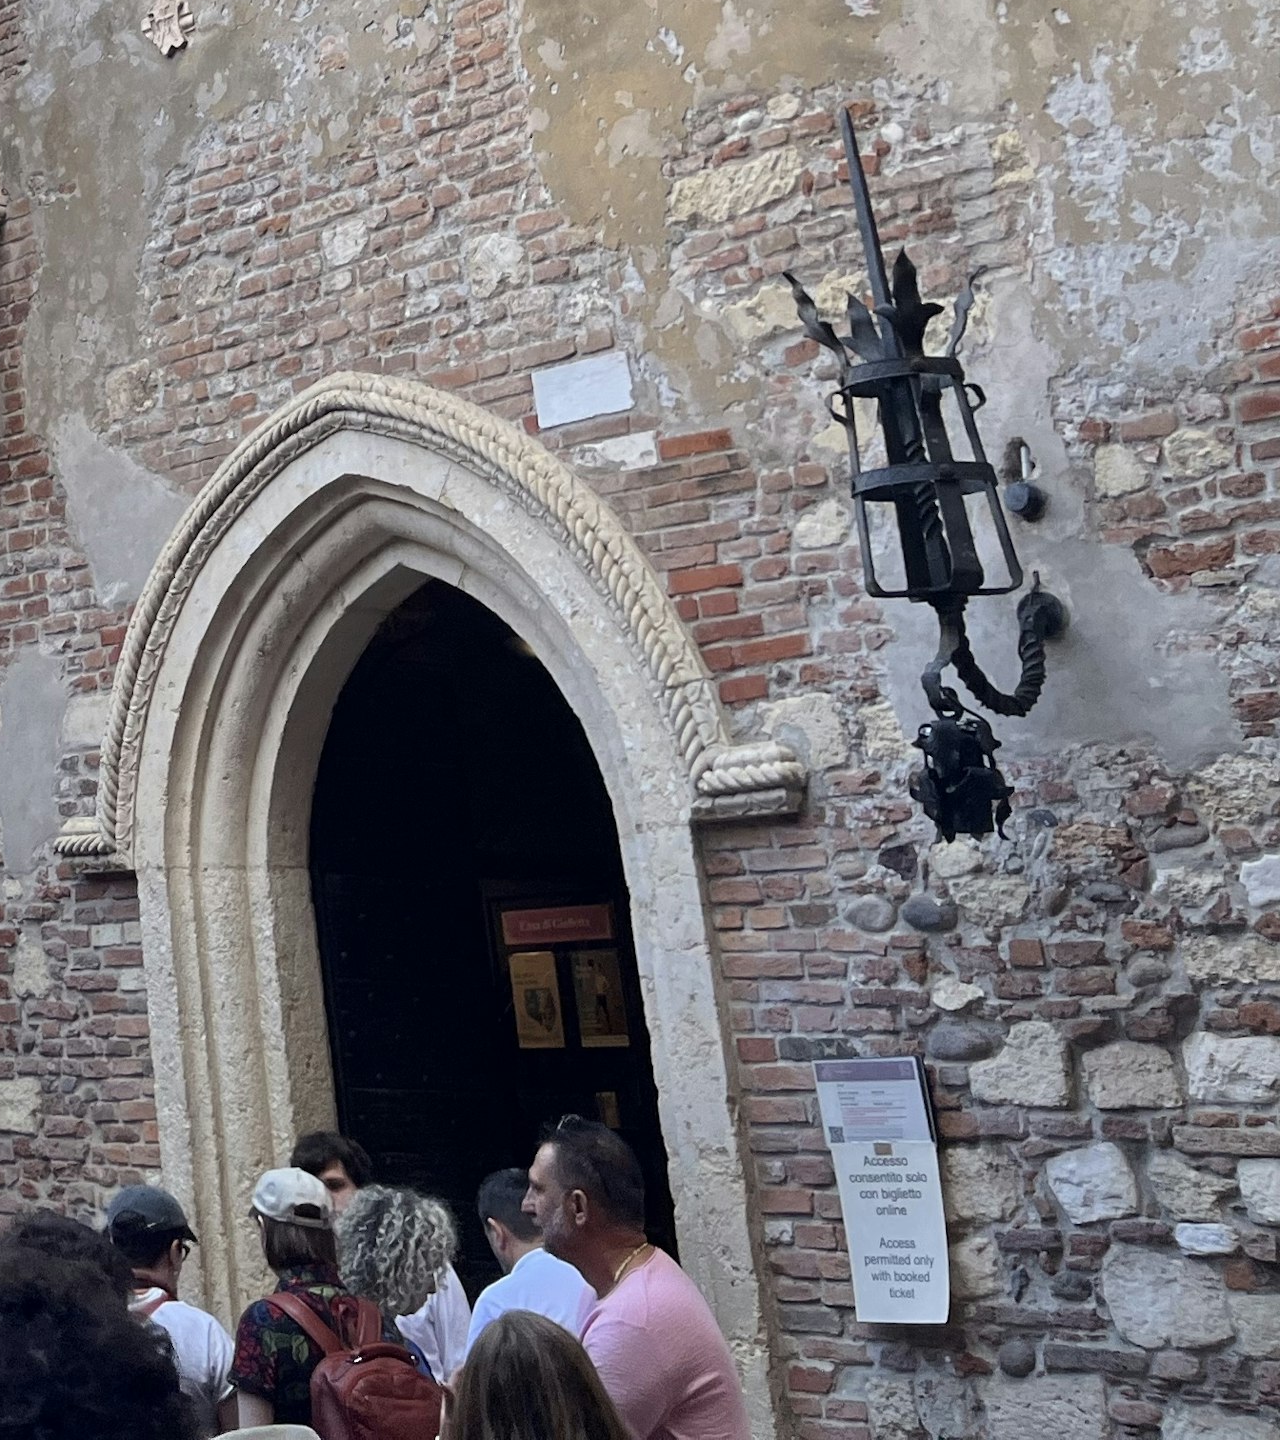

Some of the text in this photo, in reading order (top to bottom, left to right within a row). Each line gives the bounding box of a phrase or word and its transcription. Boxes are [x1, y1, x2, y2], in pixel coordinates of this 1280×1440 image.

[863, 1155, 908, 1167] Accesso
[848, 1171, 928, 1183] consentito solo
[859, 1187, 922, 1202] con biglietto
[875, 1204, 908, 1216] online
[879, 1236, 916, 1249] Access
[864, 1253, 935, 1269] permitted only
[871, 1270, 931, 1283] with booked
[889, 1287, 915, 1299] ticket
